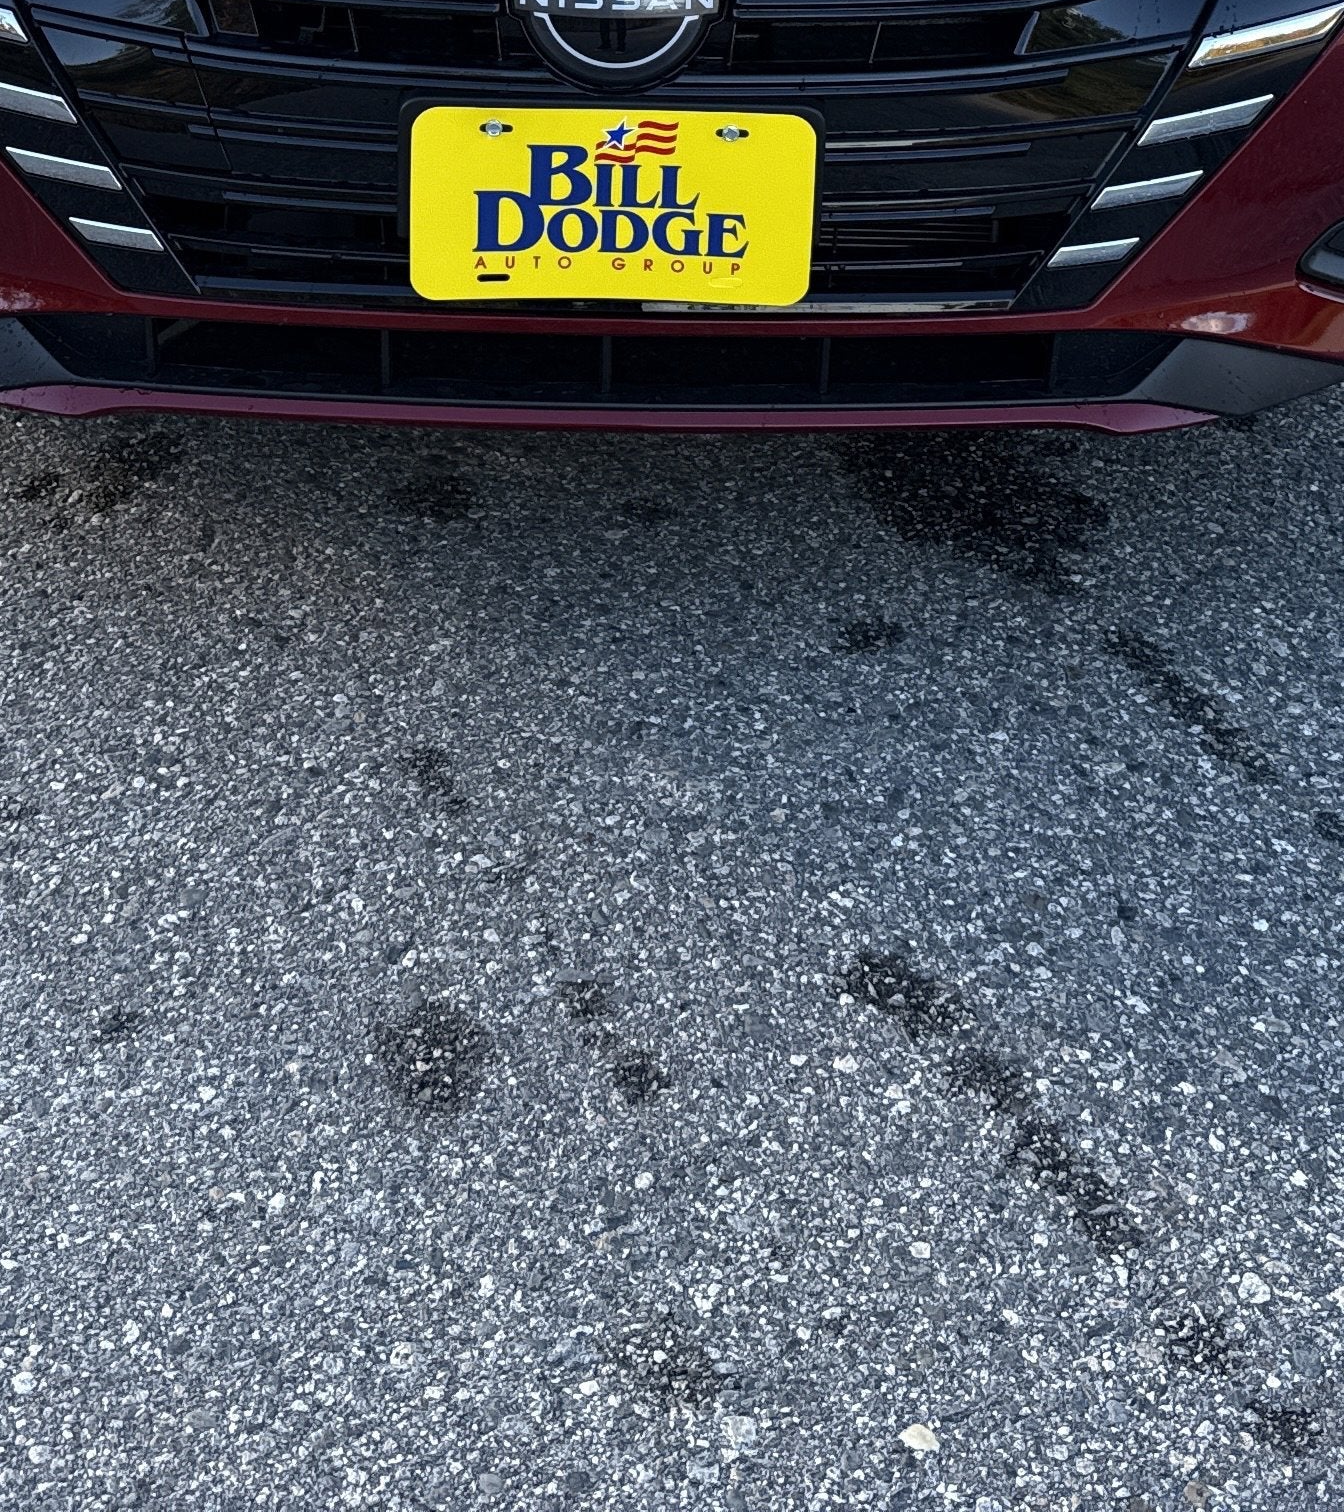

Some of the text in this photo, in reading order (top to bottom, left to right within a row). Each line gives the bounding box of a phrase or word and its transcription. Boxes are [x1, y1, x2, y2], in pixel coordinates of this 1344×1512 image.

[527, 144, 700, 209] BILL
[472, 190, 749, 259] DODGE
[474, 255, 741, 276] AUTO GROUP
